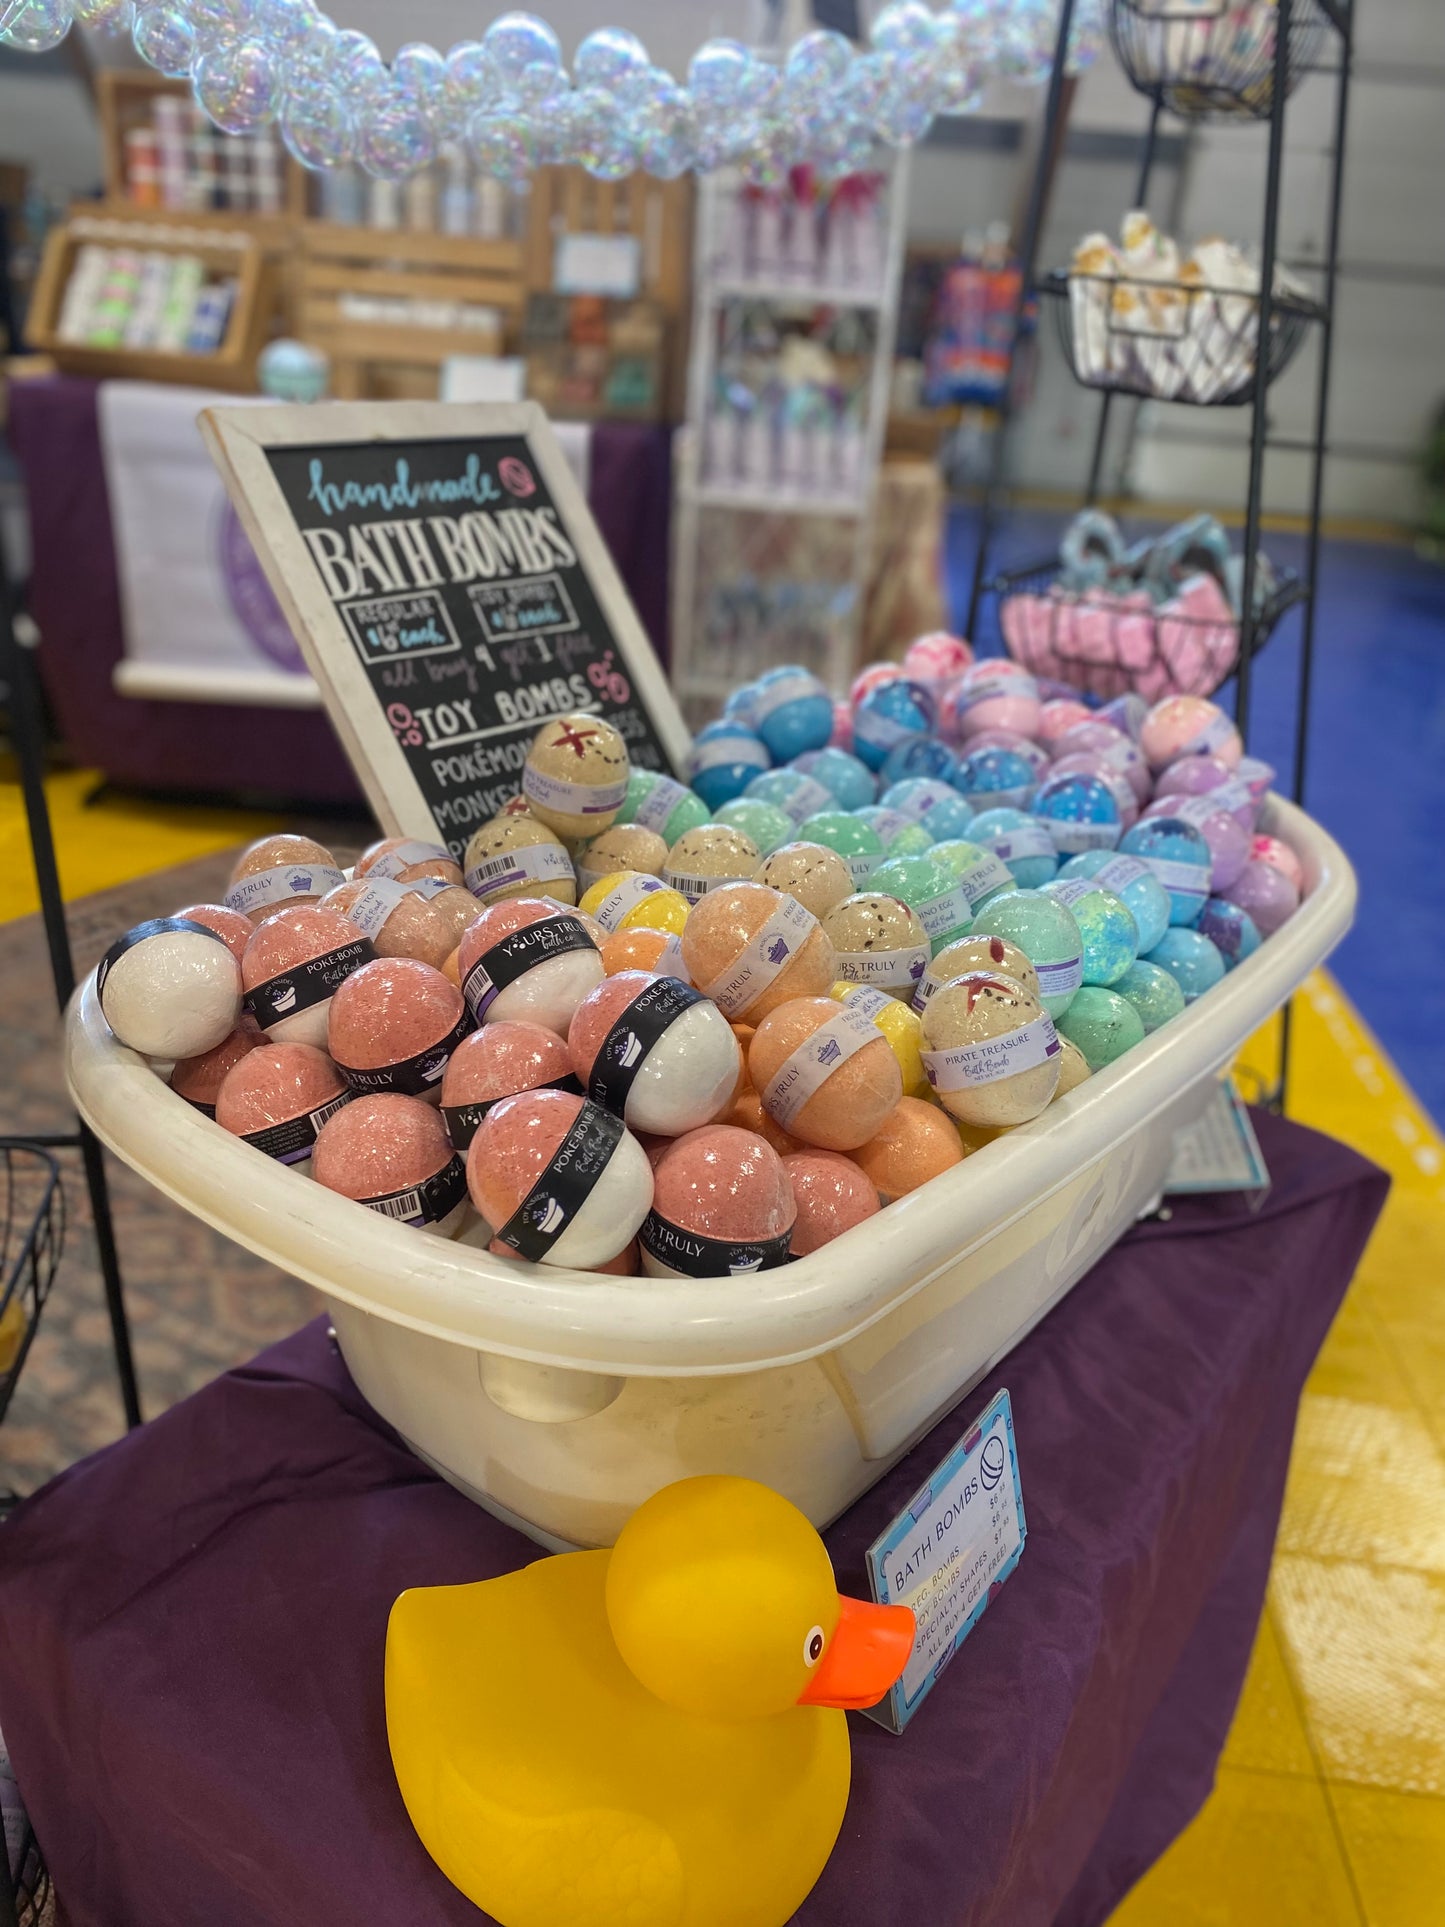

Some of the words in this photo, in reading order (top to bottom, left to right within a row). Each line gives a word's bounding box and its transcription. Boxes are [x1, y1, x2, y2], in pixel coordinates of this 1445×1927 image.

[302, 518, 446, 600] BATH
[427, 507, 578, 583] BOMBS
[415, 699, 478, 741] TOY
[495, 673, 594, 724] BOMBS
[433, 781, 521, 829] MONKEY
[241, 877, 273, 896] TRULY
[598, 893, 623, 926] TRULY
[939, 899, 954, 911] EGG
[306, 944, 363, 974] POKE-BOMB
[322, 965, 342, 984] Bath
[860, 960, 896, 972] TRULY
[725, 967, 753, 993] TRULY
[945, 1050, 978, 1065] PIRATE
[979, 1032, 1030, 1057] TREASURE
[350, 1072, 394, 1085] TRULY
[962, 1060, 985, 1077] Bath
[984, 1054, 1010, 1072] Bomb
[774, 1066, 800, 1099] TRULY
[553, 1109, 595, 1173] POKE-BOMB
[574, 1144, 596, 1173] Bath
[658, 1224, 705, 1257] TRULY
[895, 1539, 932, 1592] BATH
[936, 1476, 979, 1541] BOMBS
[912, 1588, 930, 1612] REG.
[932, 1545, 960, 1588] BOMBS
[933, 1566, 961, 1609] BOMBS
[916, 1591, 958, 1654] SPECIALTY
[960, 1550, 988, 1593] SHAPES
[928, 1637, 943, 1659] ALL
[945, 1610, 959, 1637] BUY
[967, 1579, 981, 1603] GET
[988, 1543, 1007, 1575] FREE!
